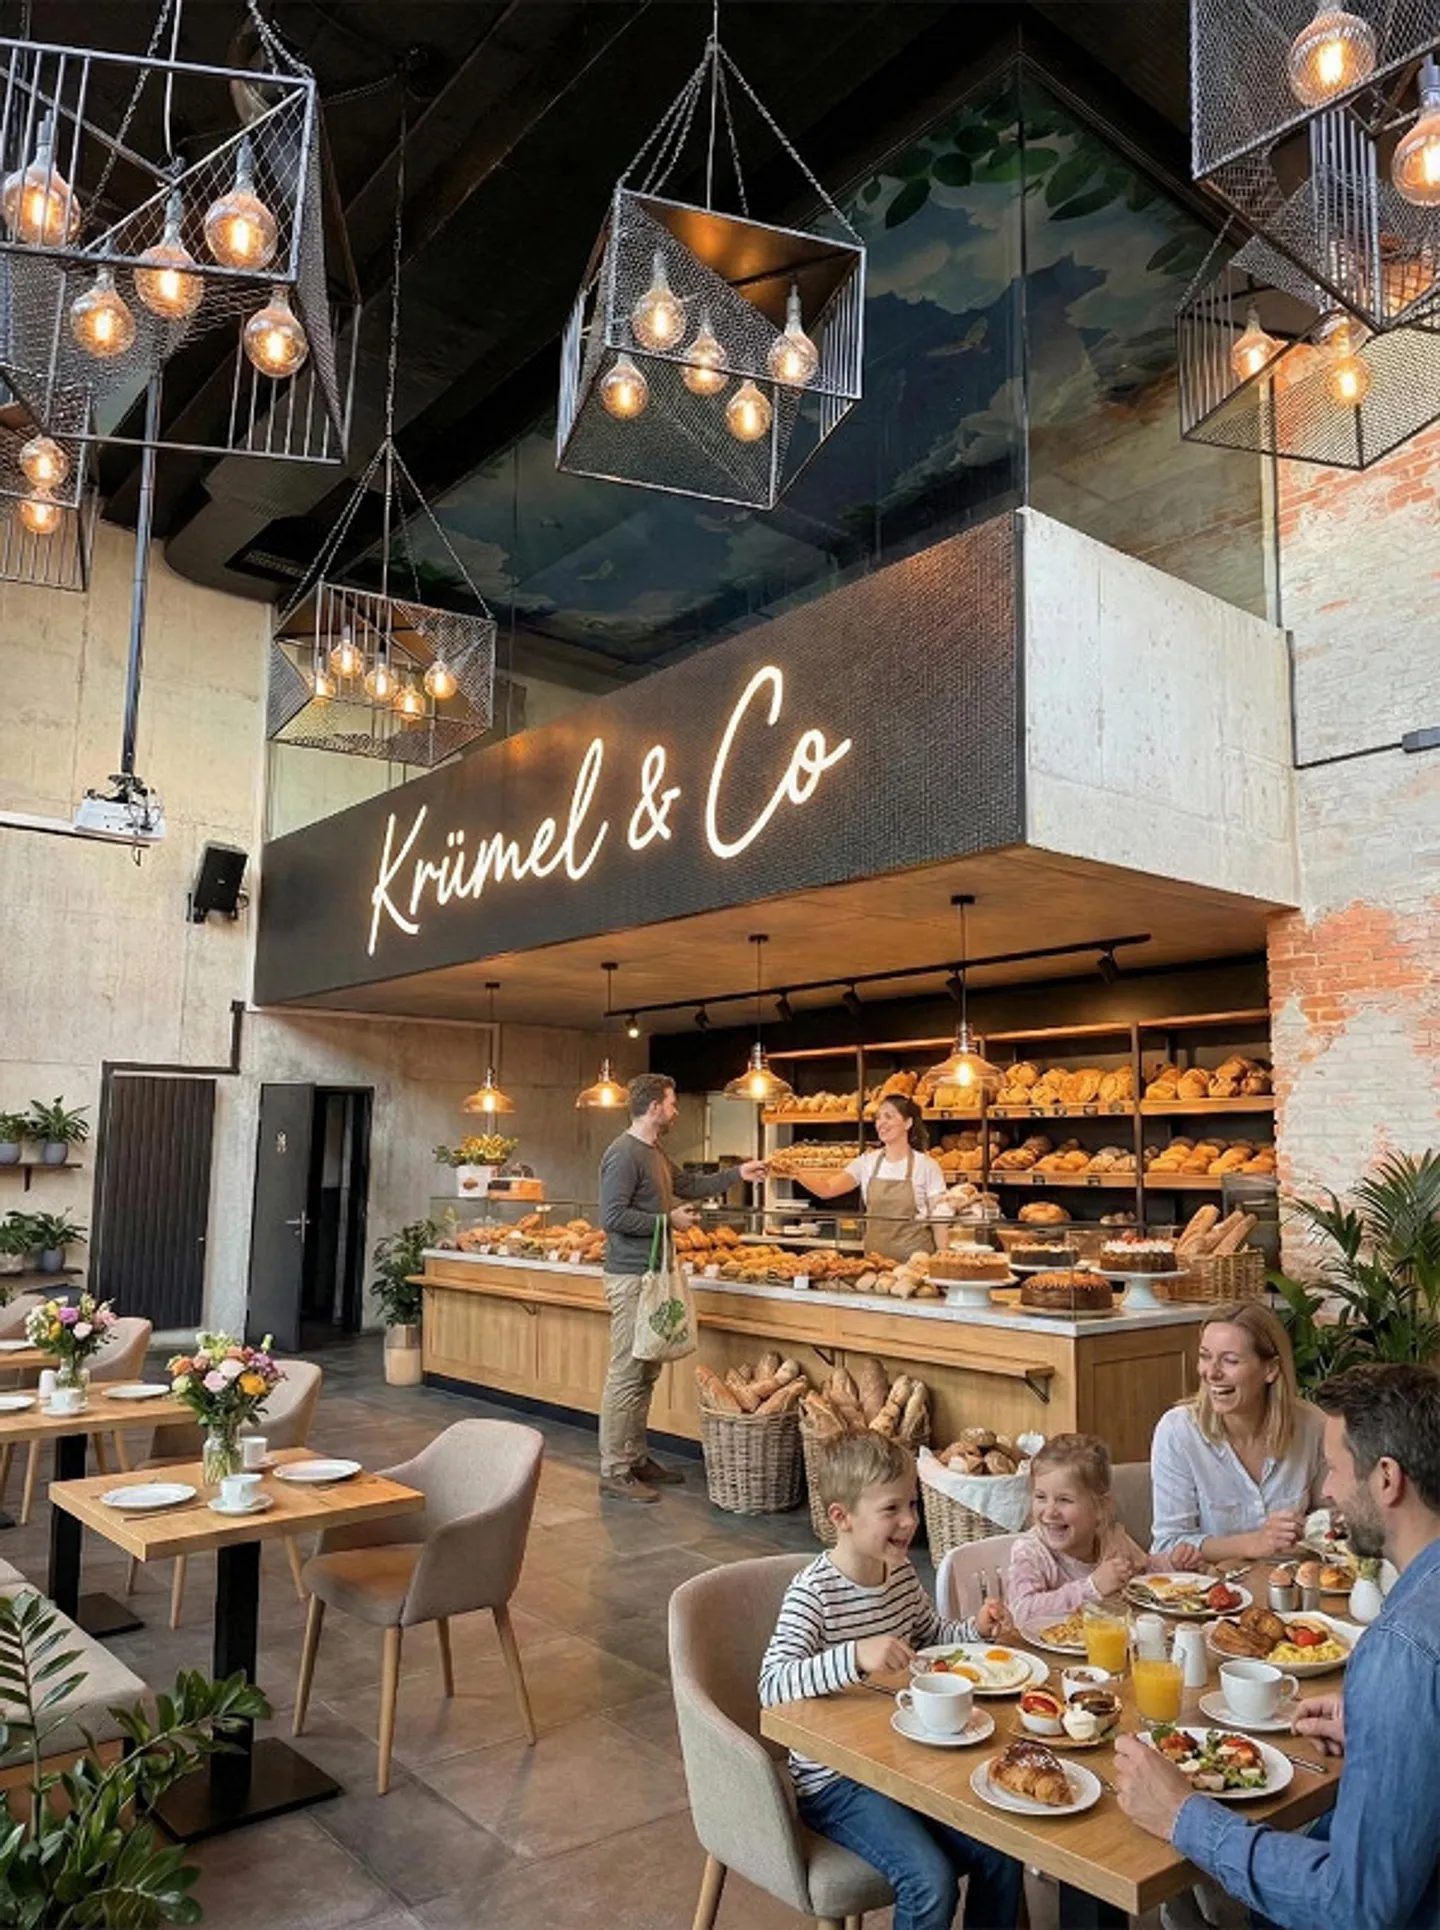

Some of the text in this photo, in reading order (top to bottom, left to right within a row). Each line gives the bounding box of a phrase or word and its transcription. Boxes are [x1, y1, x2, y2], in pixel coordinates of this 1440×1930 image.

[368, 665, 853, 956] Krümel & Co
